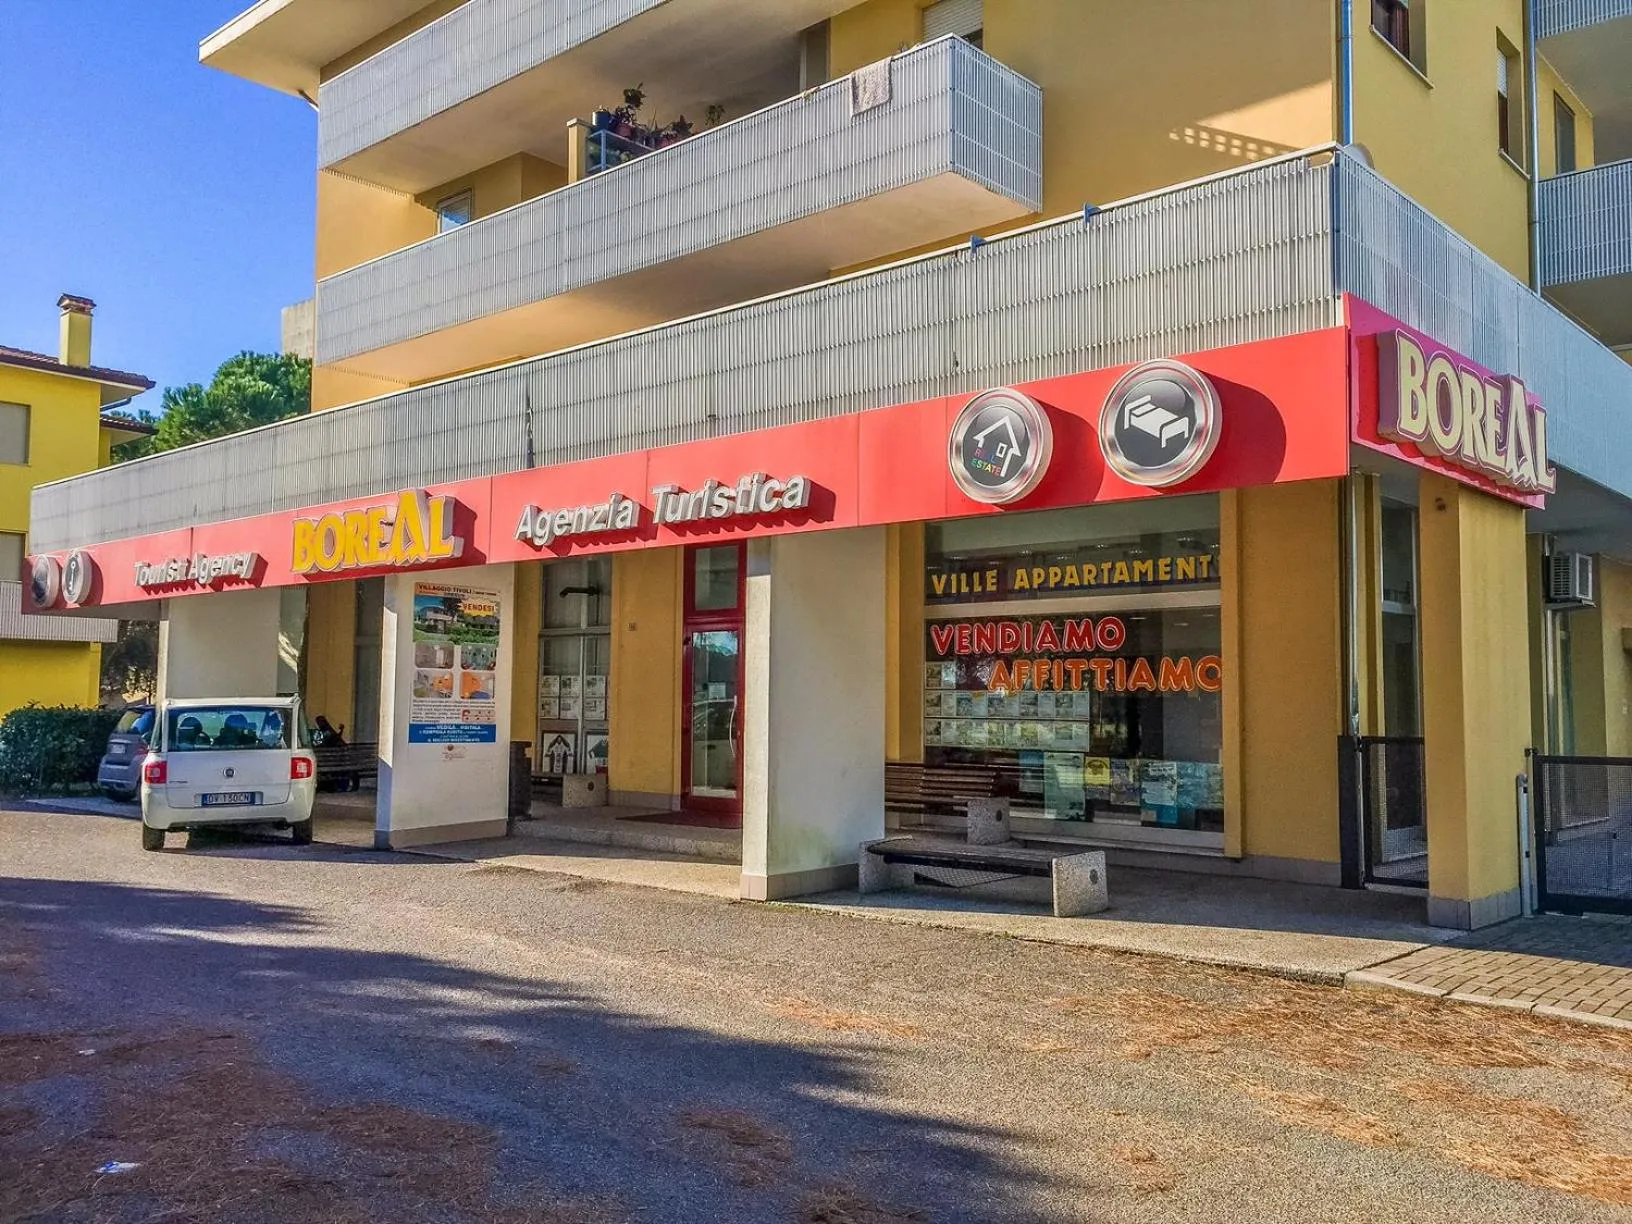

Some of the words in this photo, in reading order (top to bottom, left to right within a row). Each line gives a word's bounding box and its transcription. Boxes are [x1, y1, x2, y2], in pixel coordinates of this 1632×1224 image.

[1393, 328, 1556, 494] BOREAL
[971, 458, 1001, 478] ESTATE
[515, 492, 640, 547] Agenzia
[651, 472, 810, 525] Turistica
[293, 489, 460, 573] BOREAL
[134, 557, 186, 587] Tourist
[185, 552, 256, 583] Agency
[931, 569, 999, 596] VILLE
[1014, 554, 1220, 591] APPARTAMENT
[463, 602, 495, 612] VENDESI
[930, 615, 1127, 656] VENDIAMO
[988, 655, 1222, 692] AFFITTIAMO
